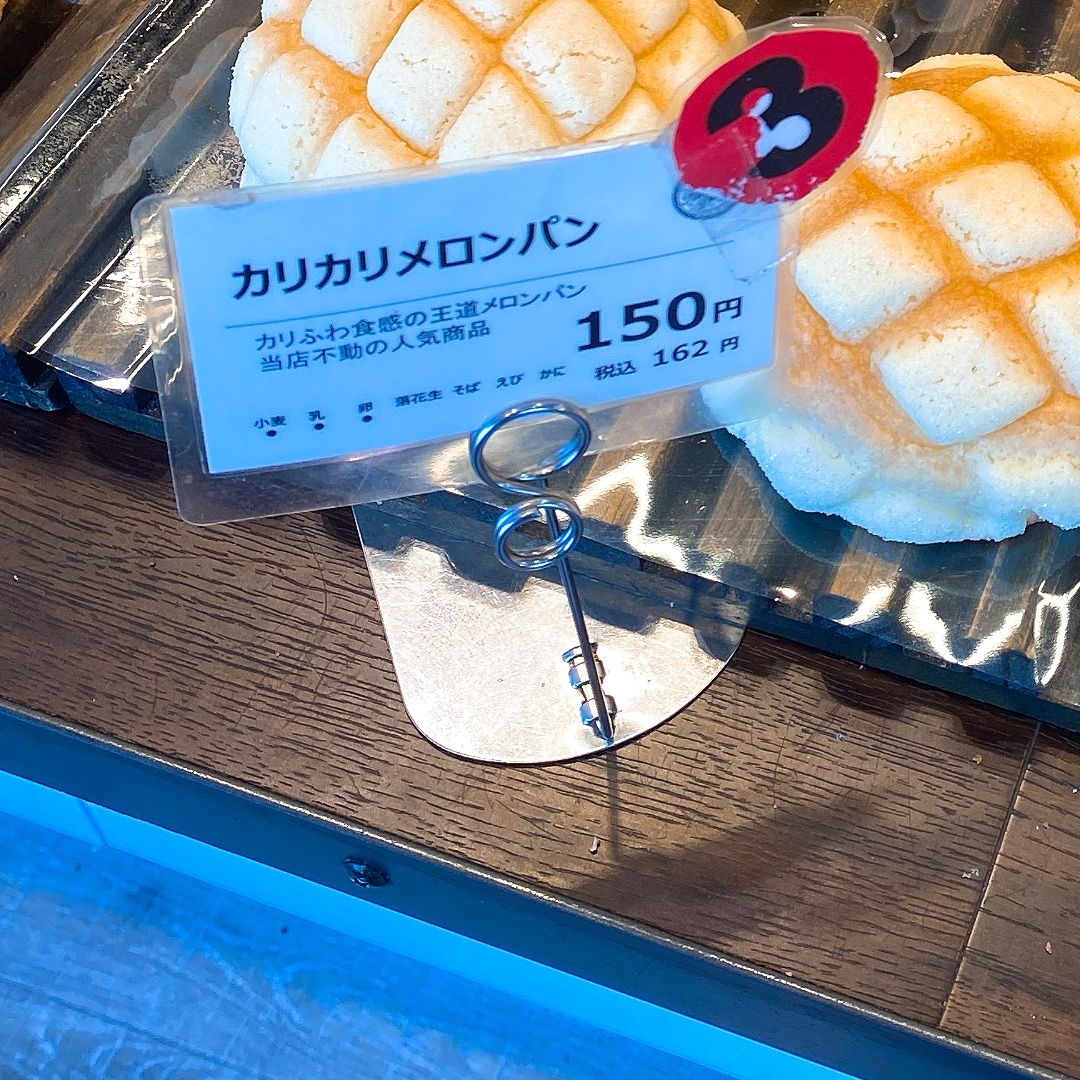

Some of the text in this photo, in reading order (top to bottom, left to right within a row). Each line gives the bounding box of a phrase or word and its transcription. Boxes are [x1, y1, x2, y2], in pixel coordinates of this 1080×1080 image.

[232, 215, 600, 299] カリカリメロンパン
[255, 284, 587, 351] カリふわ食感の王道メロンパン
[260, 319, 491, 372] 当店不動の人気商品
